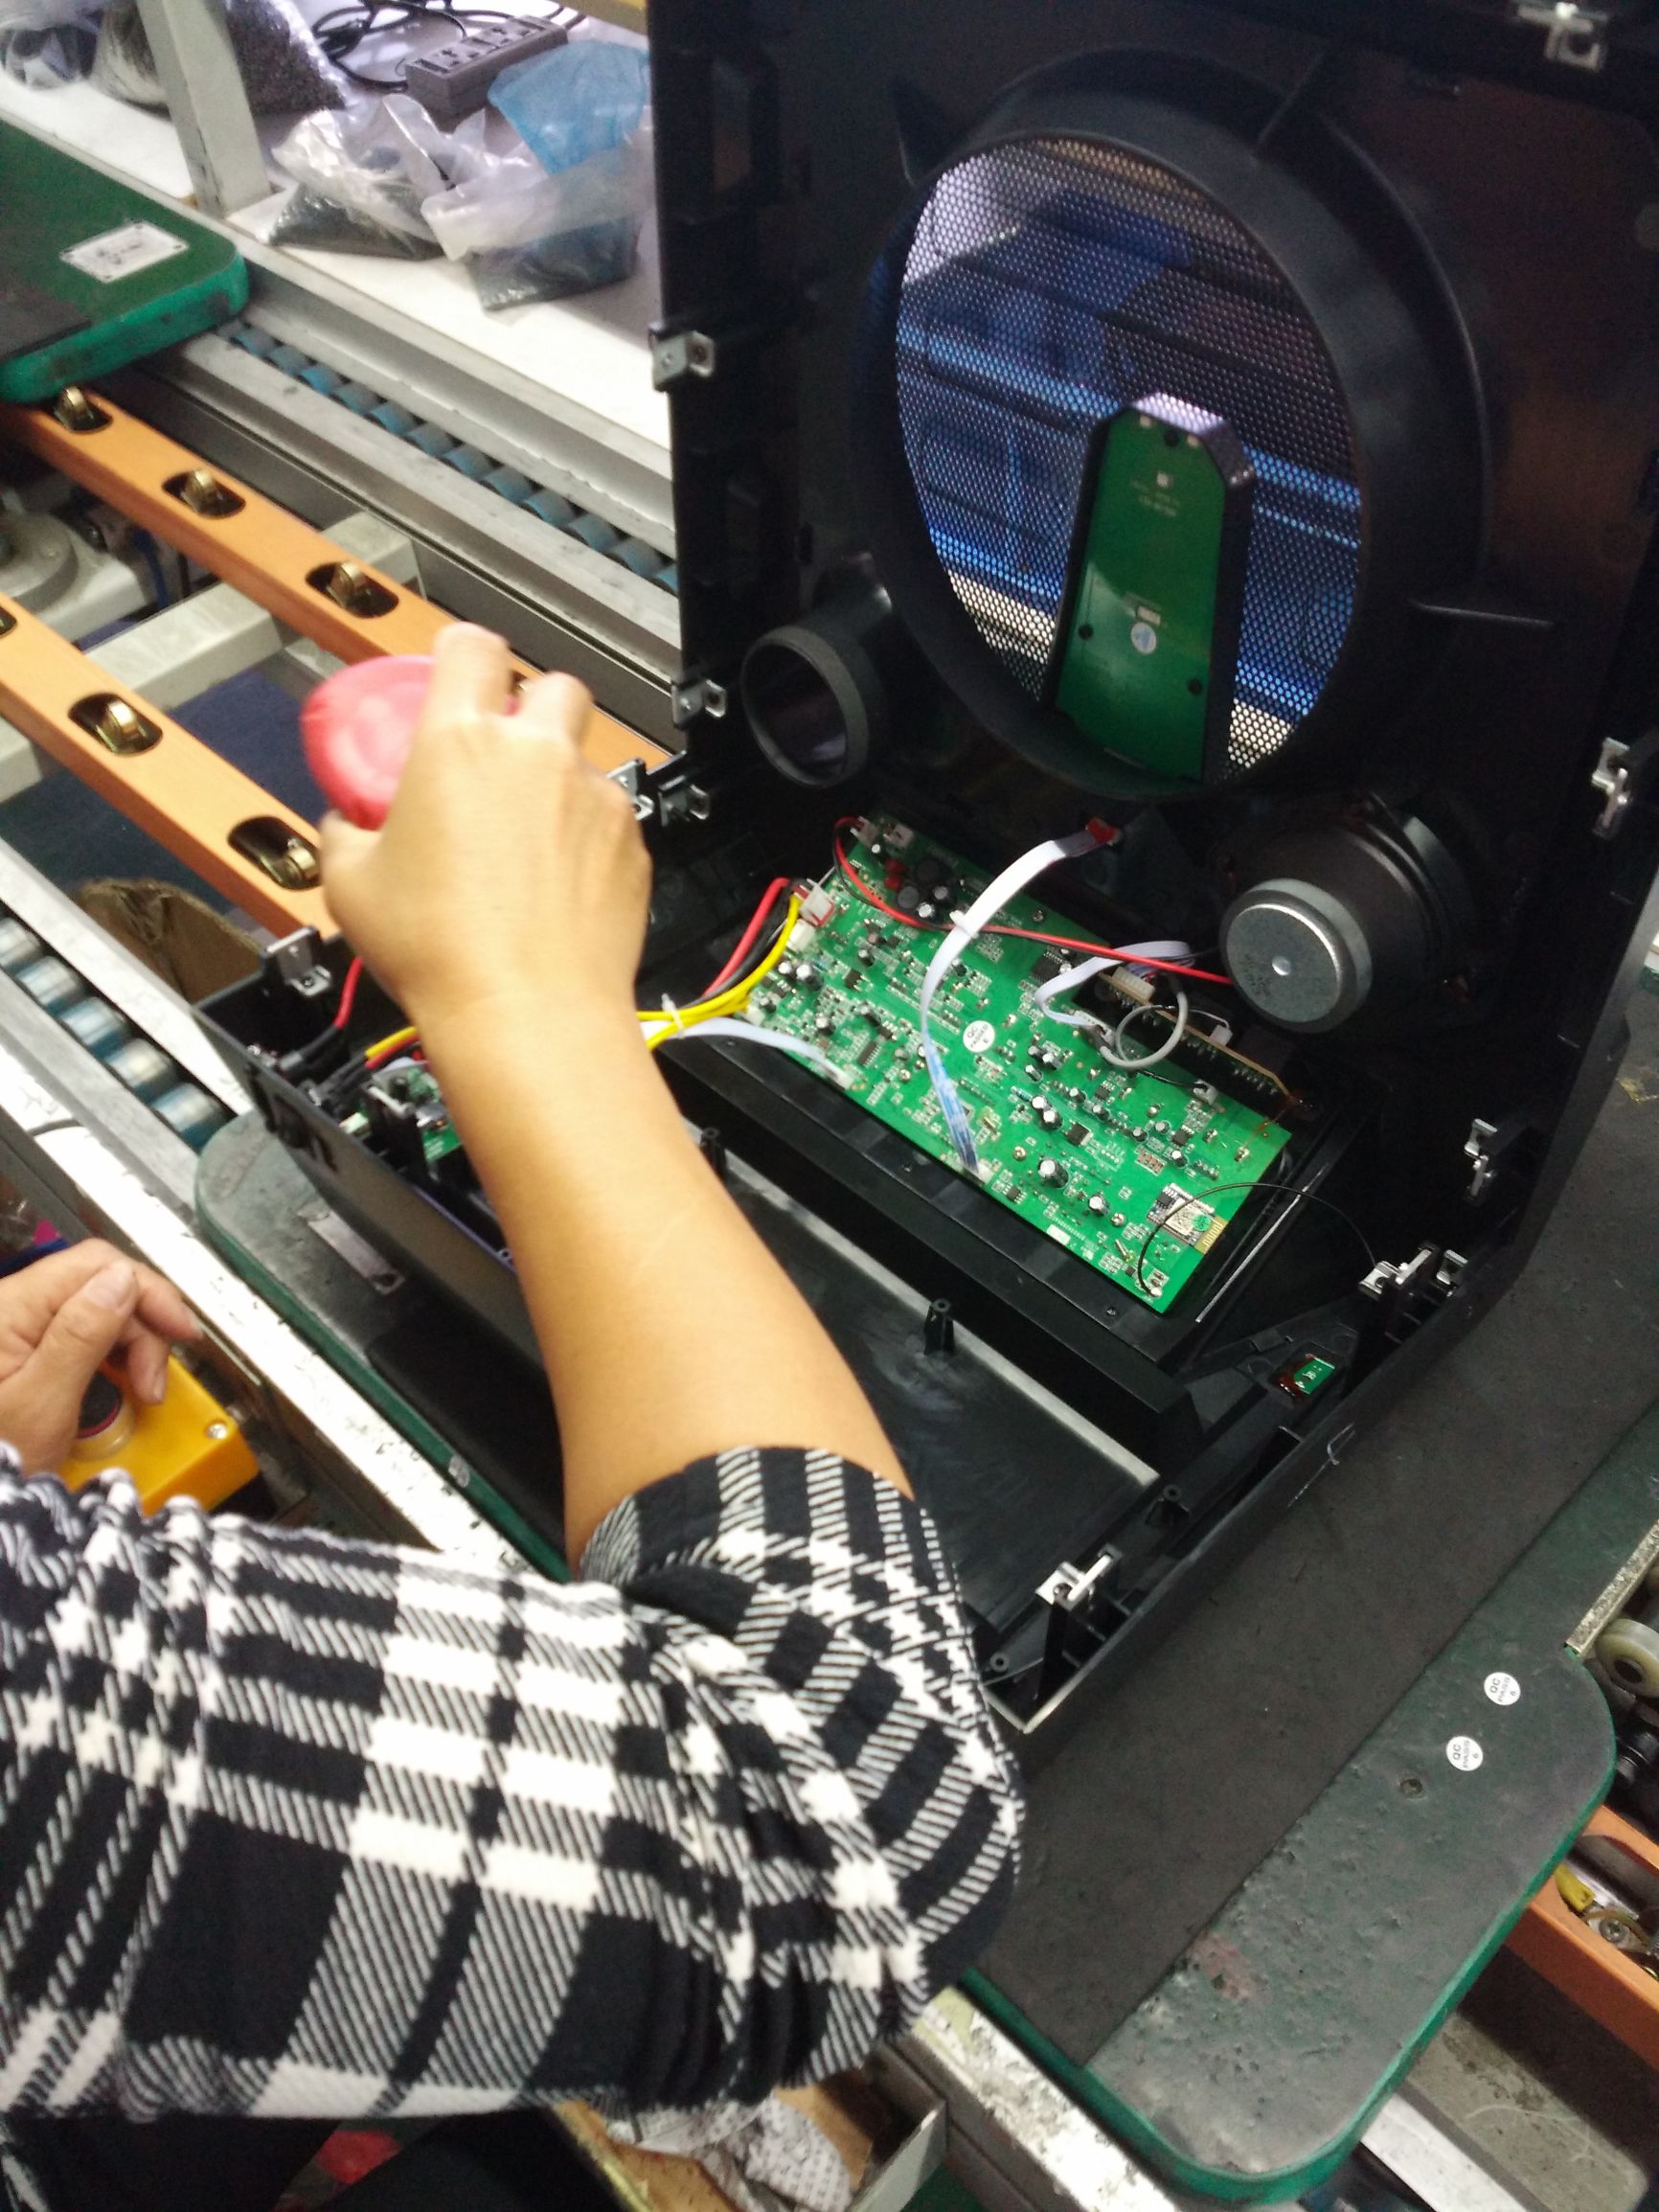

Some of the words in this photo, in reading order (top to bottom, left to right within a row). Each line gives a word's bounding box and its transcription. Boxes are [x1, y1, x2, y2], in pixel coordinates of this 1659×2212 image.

[966, 1025, 978, 1038] QC
[1489, 1677, 1501, 1694] QC
[1452, 1744, 1462, 1761] QC
